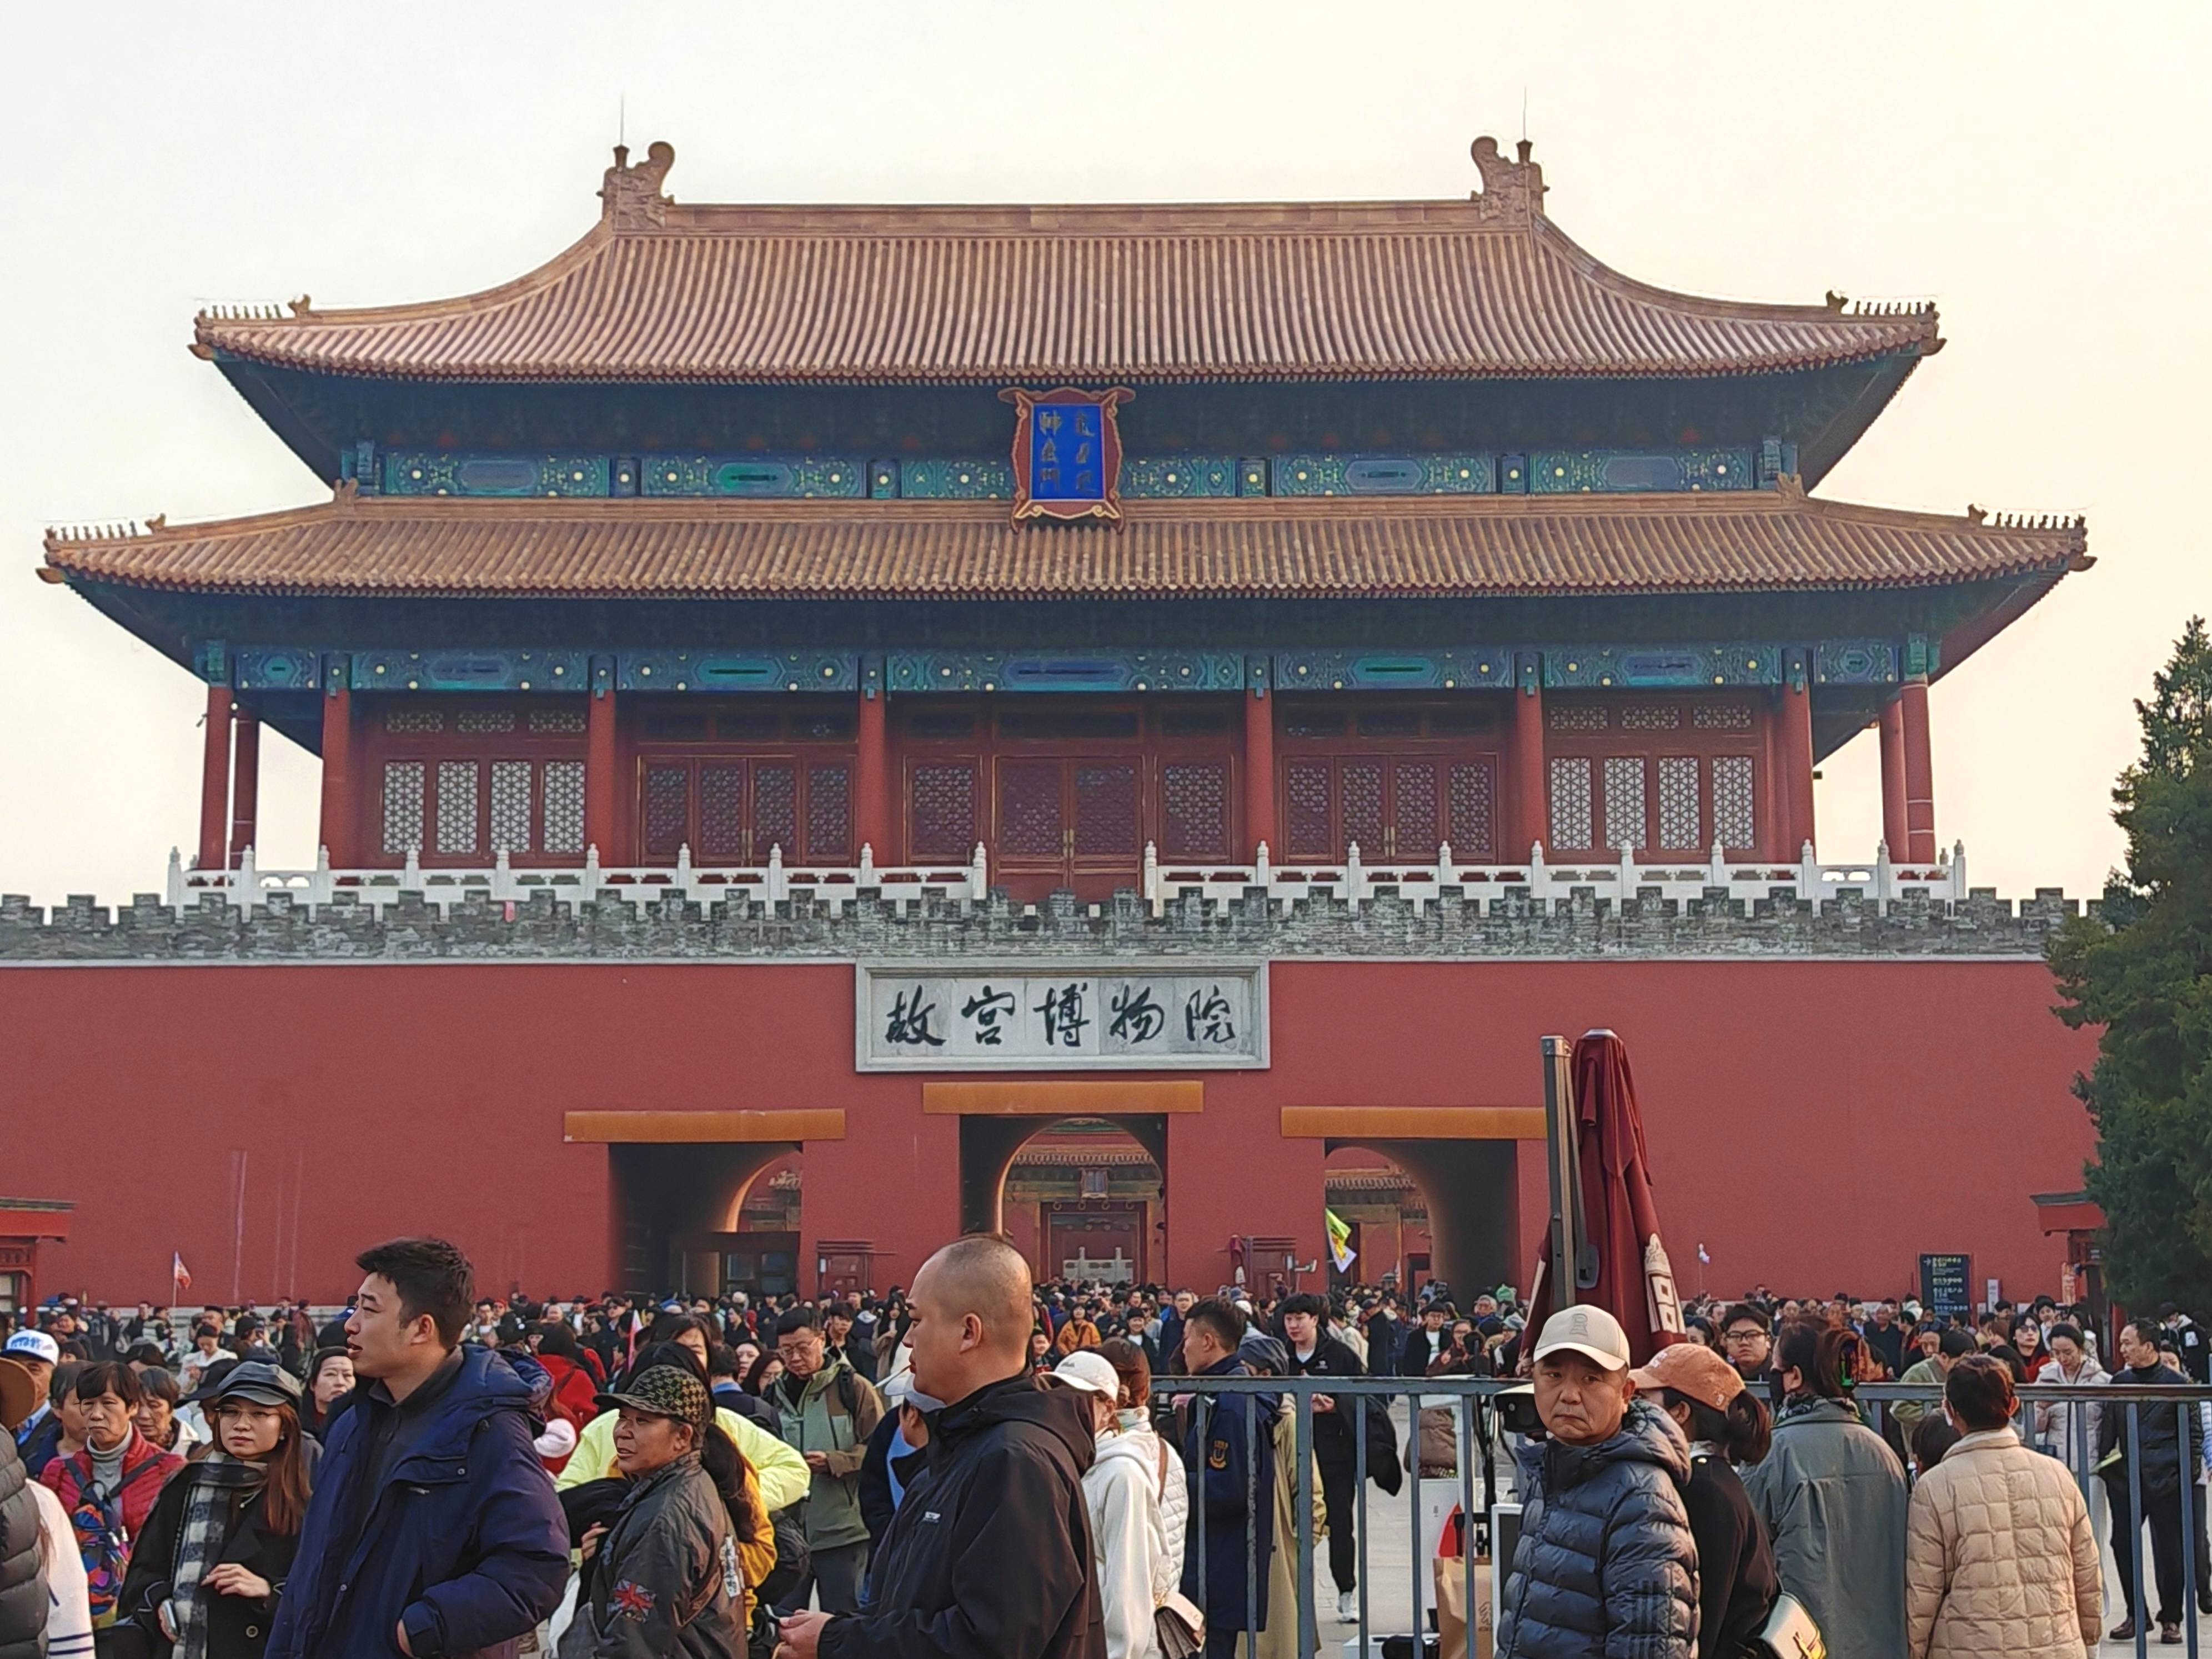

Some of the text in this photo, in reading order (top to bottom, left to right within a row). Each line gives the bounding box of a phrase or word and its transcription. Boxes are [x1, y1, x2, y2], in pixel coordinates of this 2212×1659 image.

[885, 982, 1236, 1047] 故宫博物院
